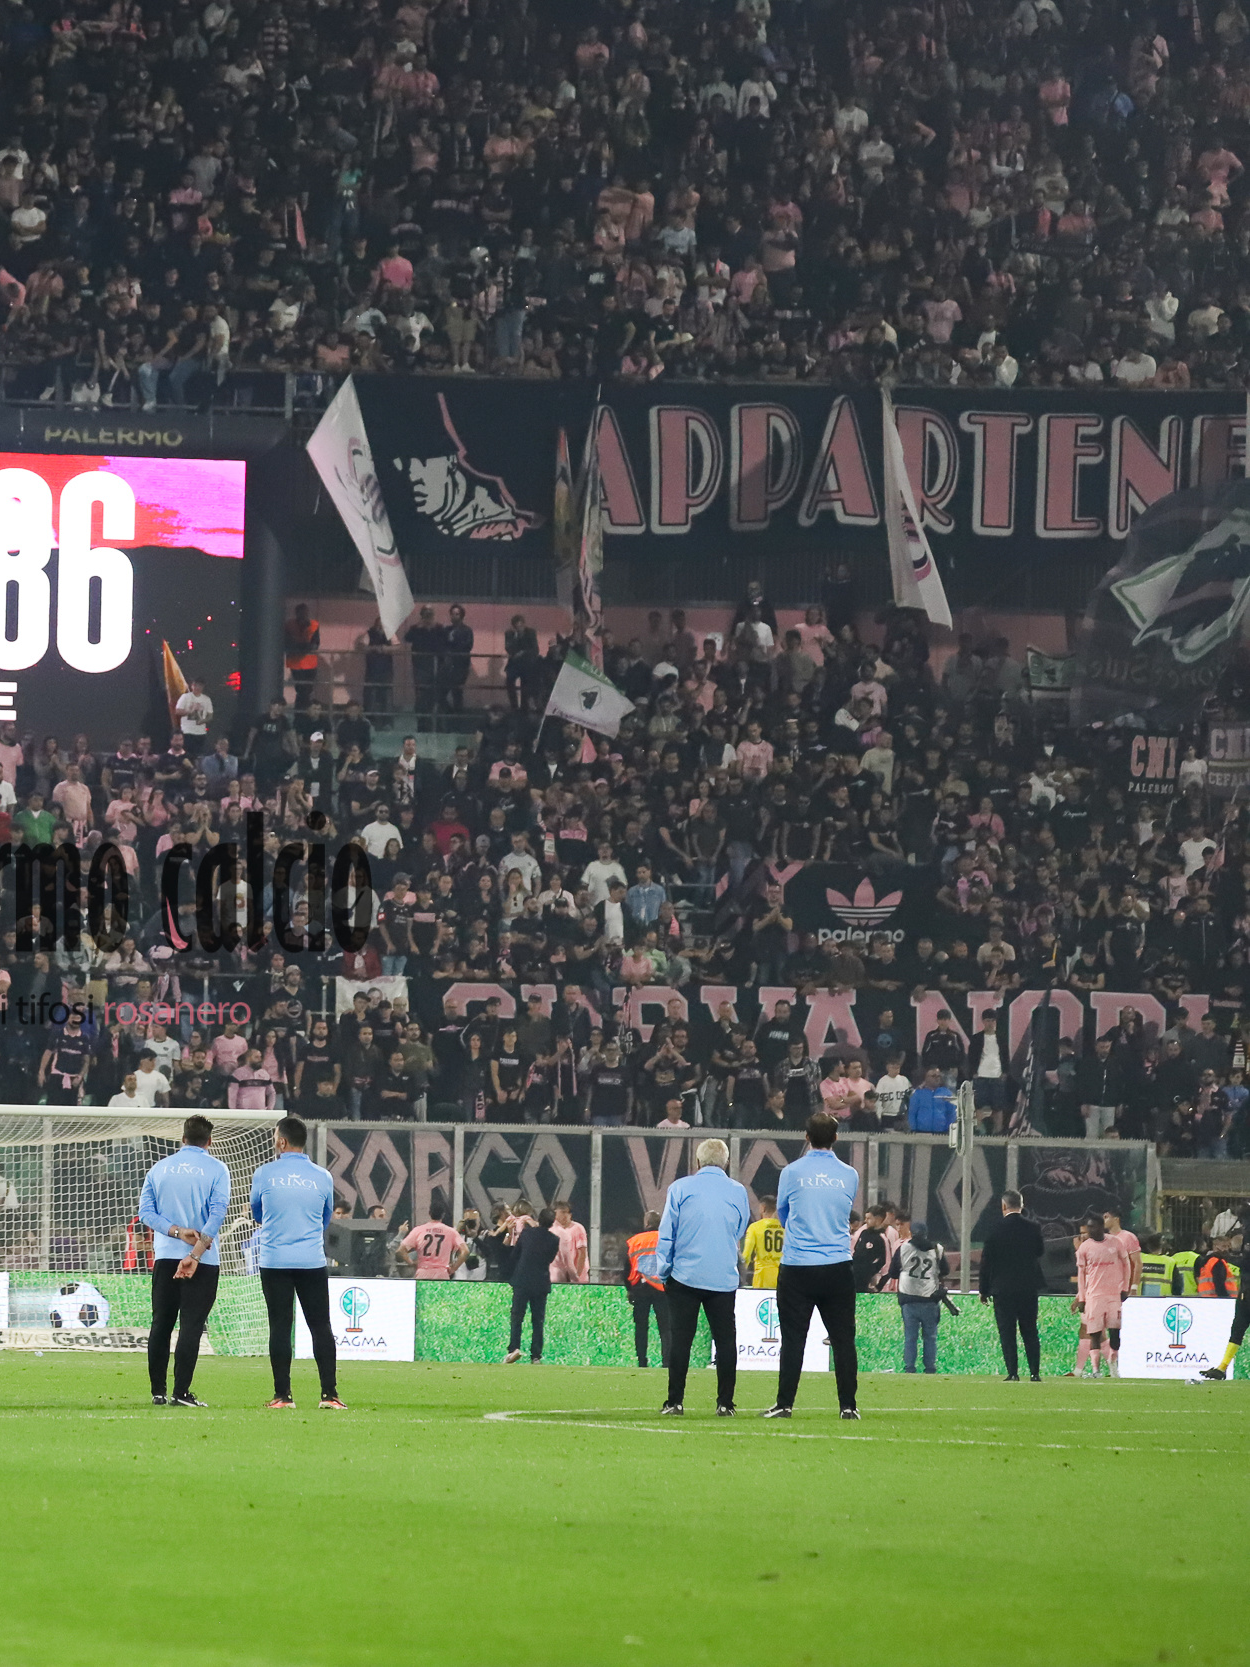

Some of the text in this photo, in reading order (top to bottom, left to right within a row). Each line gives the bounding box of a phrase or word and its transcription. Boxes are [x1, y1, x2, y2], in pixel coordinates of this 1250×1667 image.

[44, 426, 184, 447] PALERMO
[1128, 781, 1174, 794] PALERMO
[268, 1177, 318, 1190] TRINCA
[797, 1177, 846, 1189] TRINCA
[423, 1233, 445, 1257] 27
[764, 1229, 784, 1253] 66
[908, 1256, 933, 1280] 22
[53, 1331, 149, 1349] GoldBe
[333, 1335, 388, 1347] RAGMA
[738, 1344, 781, 1357] PRAG
[1146, 1351, 1210, 1363] PRAGMA
